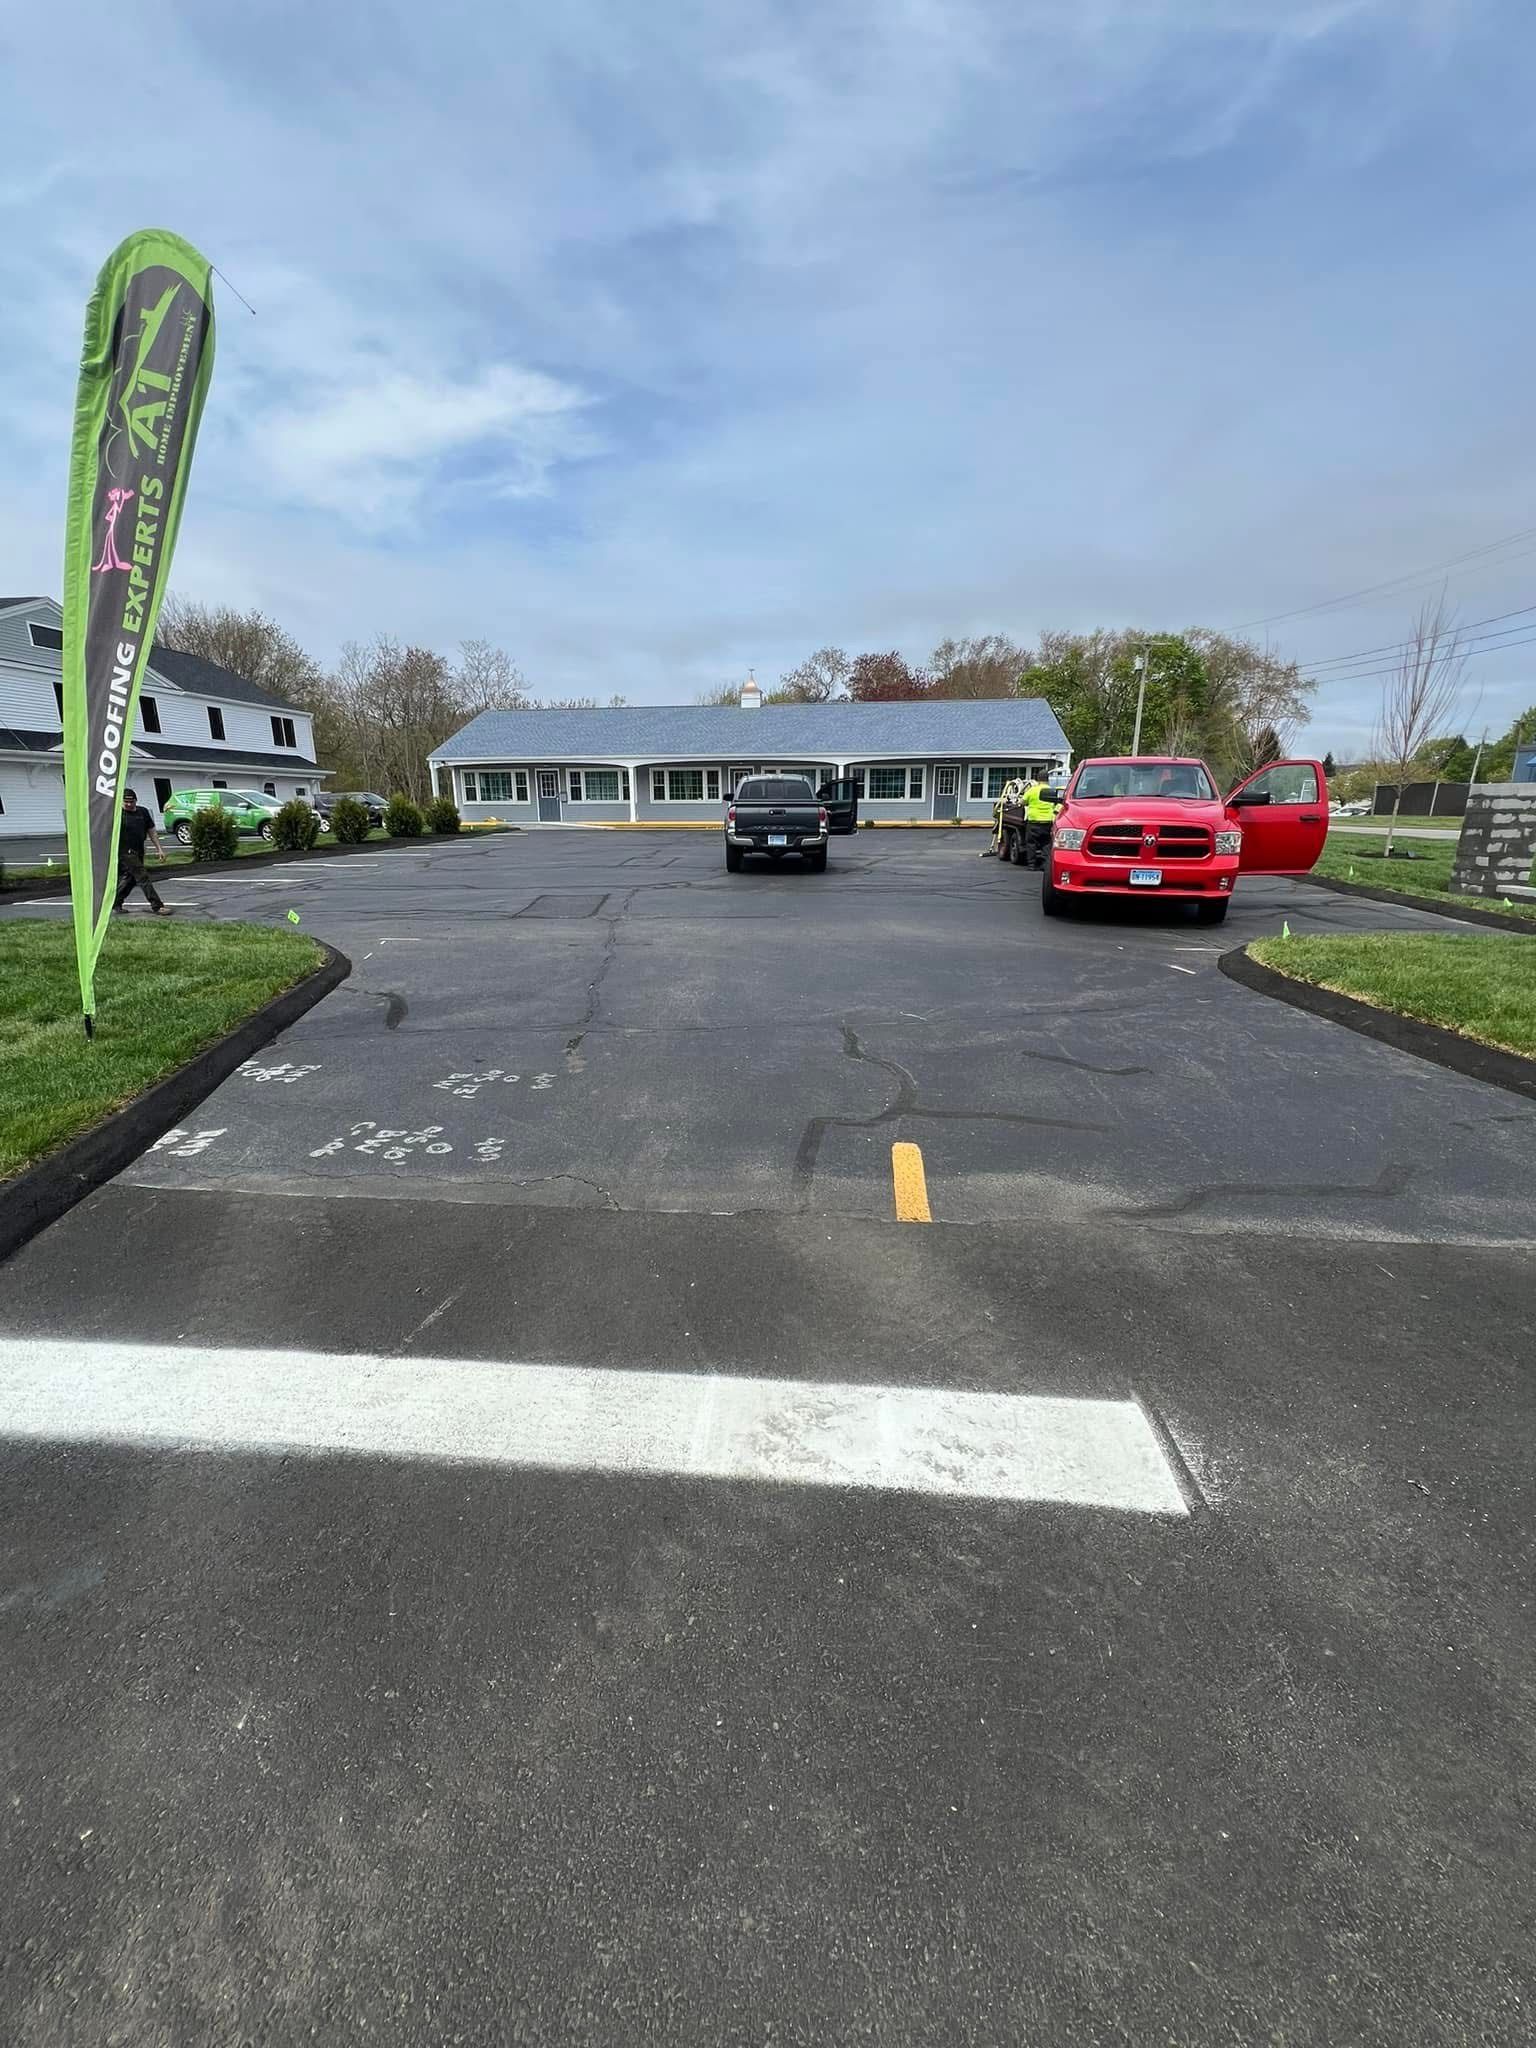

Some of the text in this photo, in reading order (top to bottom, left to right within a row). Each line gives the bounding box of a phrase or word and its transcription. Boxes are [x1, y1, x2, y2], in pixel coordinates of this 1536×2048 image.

[130, 367, 172, 451] A1
[156, 313, 198, 466] HOME IMPROVEMENT
[95, 474, 164, 798] ROOFING EXPERTS
